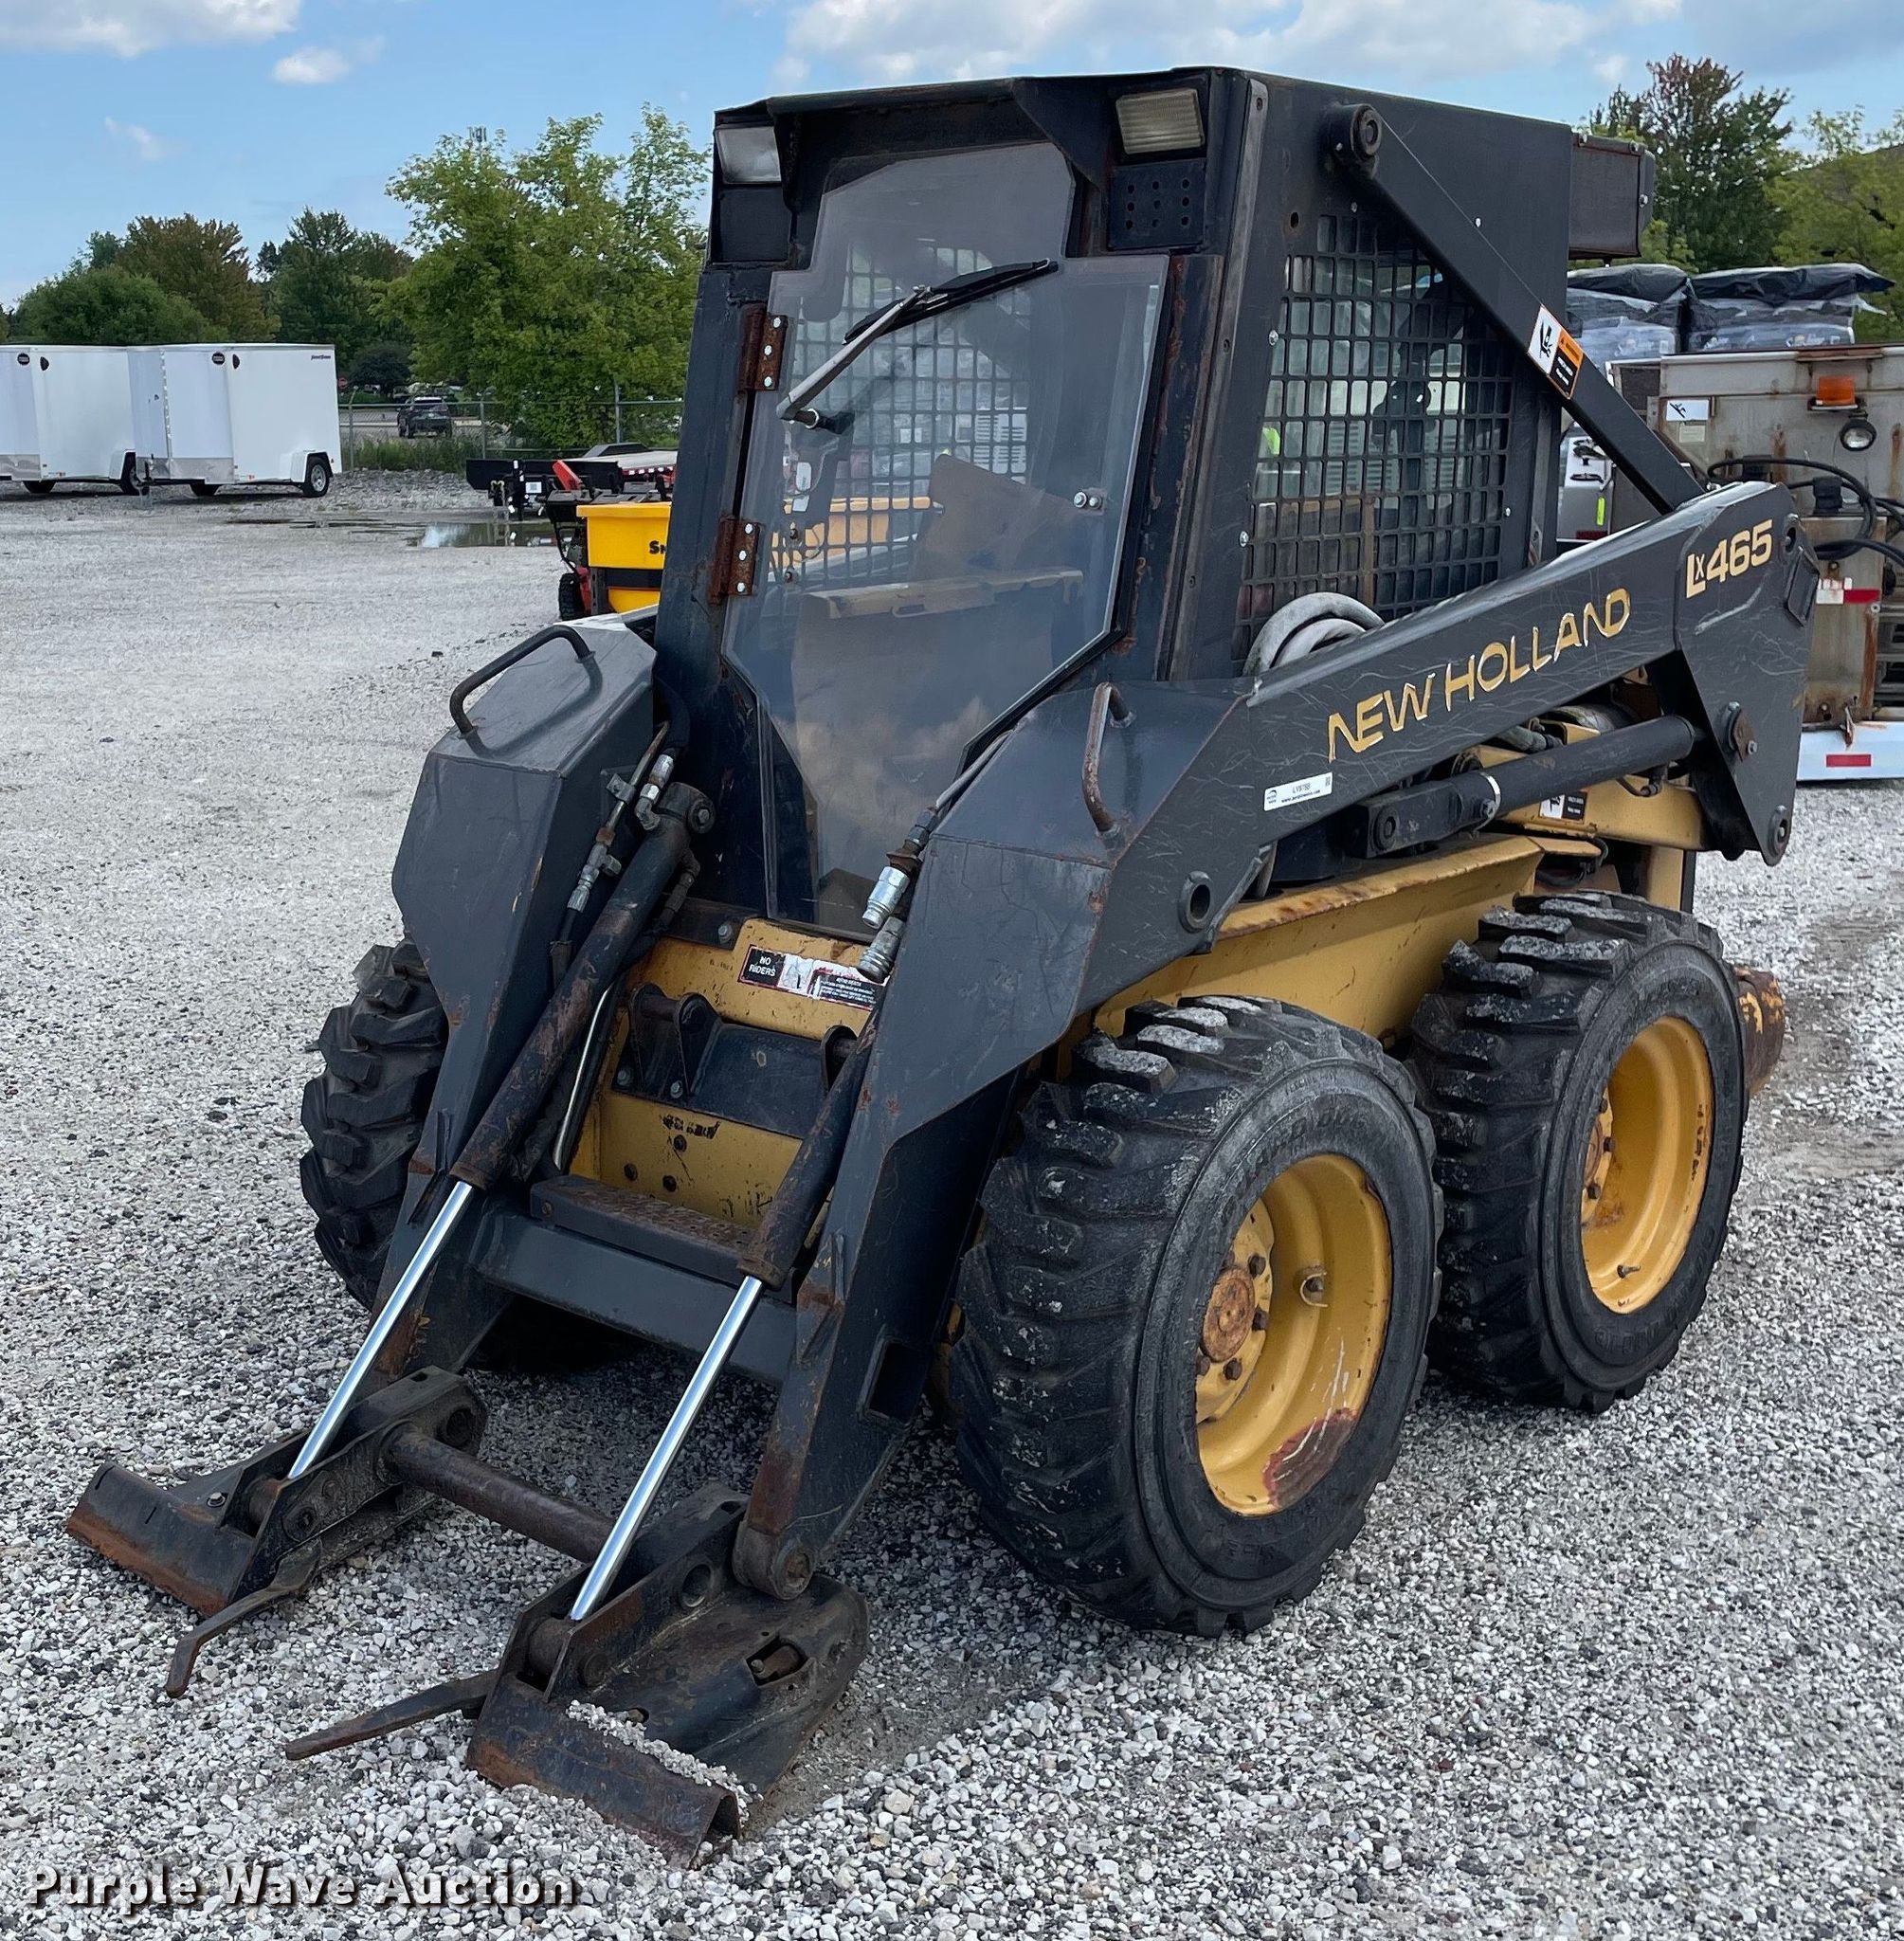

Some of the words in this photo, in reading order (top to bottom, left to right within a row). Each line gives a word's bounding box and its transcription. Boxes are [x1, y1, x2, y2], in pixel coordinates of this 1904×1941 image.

[1329, 673, 1436, 764] NEW
[1445, 589, 1630, 712] HOLLAND
[759, 956, 771, 965] NO
[749, 964, 776, 977] RIDERS
